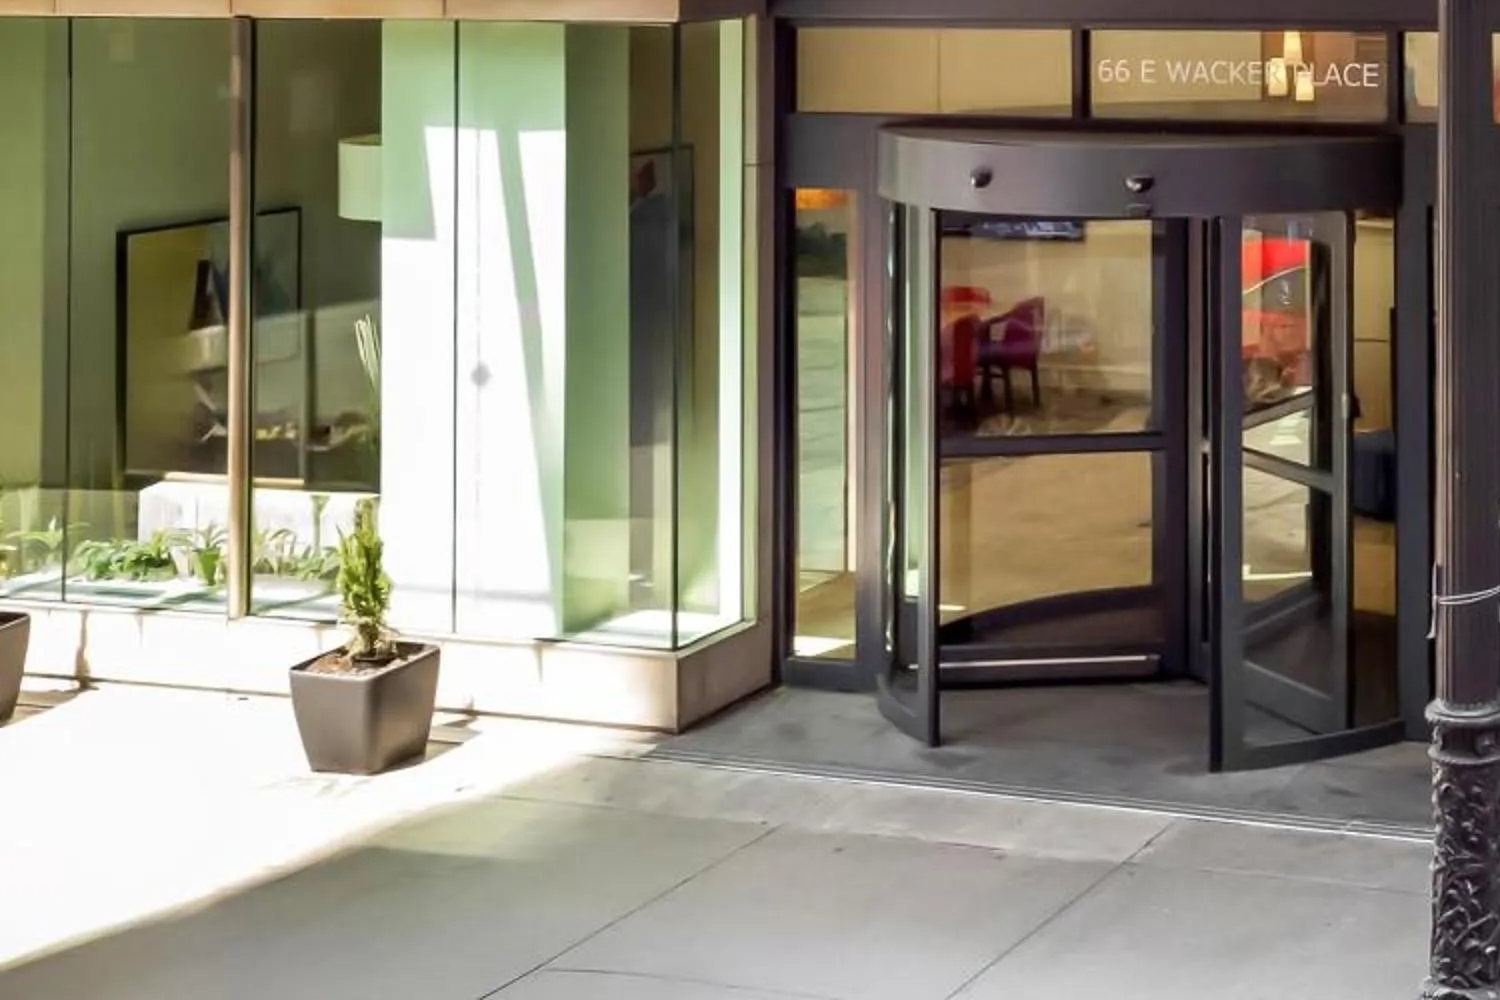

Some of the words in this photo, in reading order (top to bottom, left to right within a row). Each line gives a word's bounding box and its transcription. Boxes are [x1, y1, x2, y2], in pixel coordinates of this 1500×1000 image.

[1098, 58, 1131, 84] 66
[1140, 59, 1157, 84] E
[1166, 60, 1284, 86] WACKER
[1293, 61, 1380, 88] PLACE
